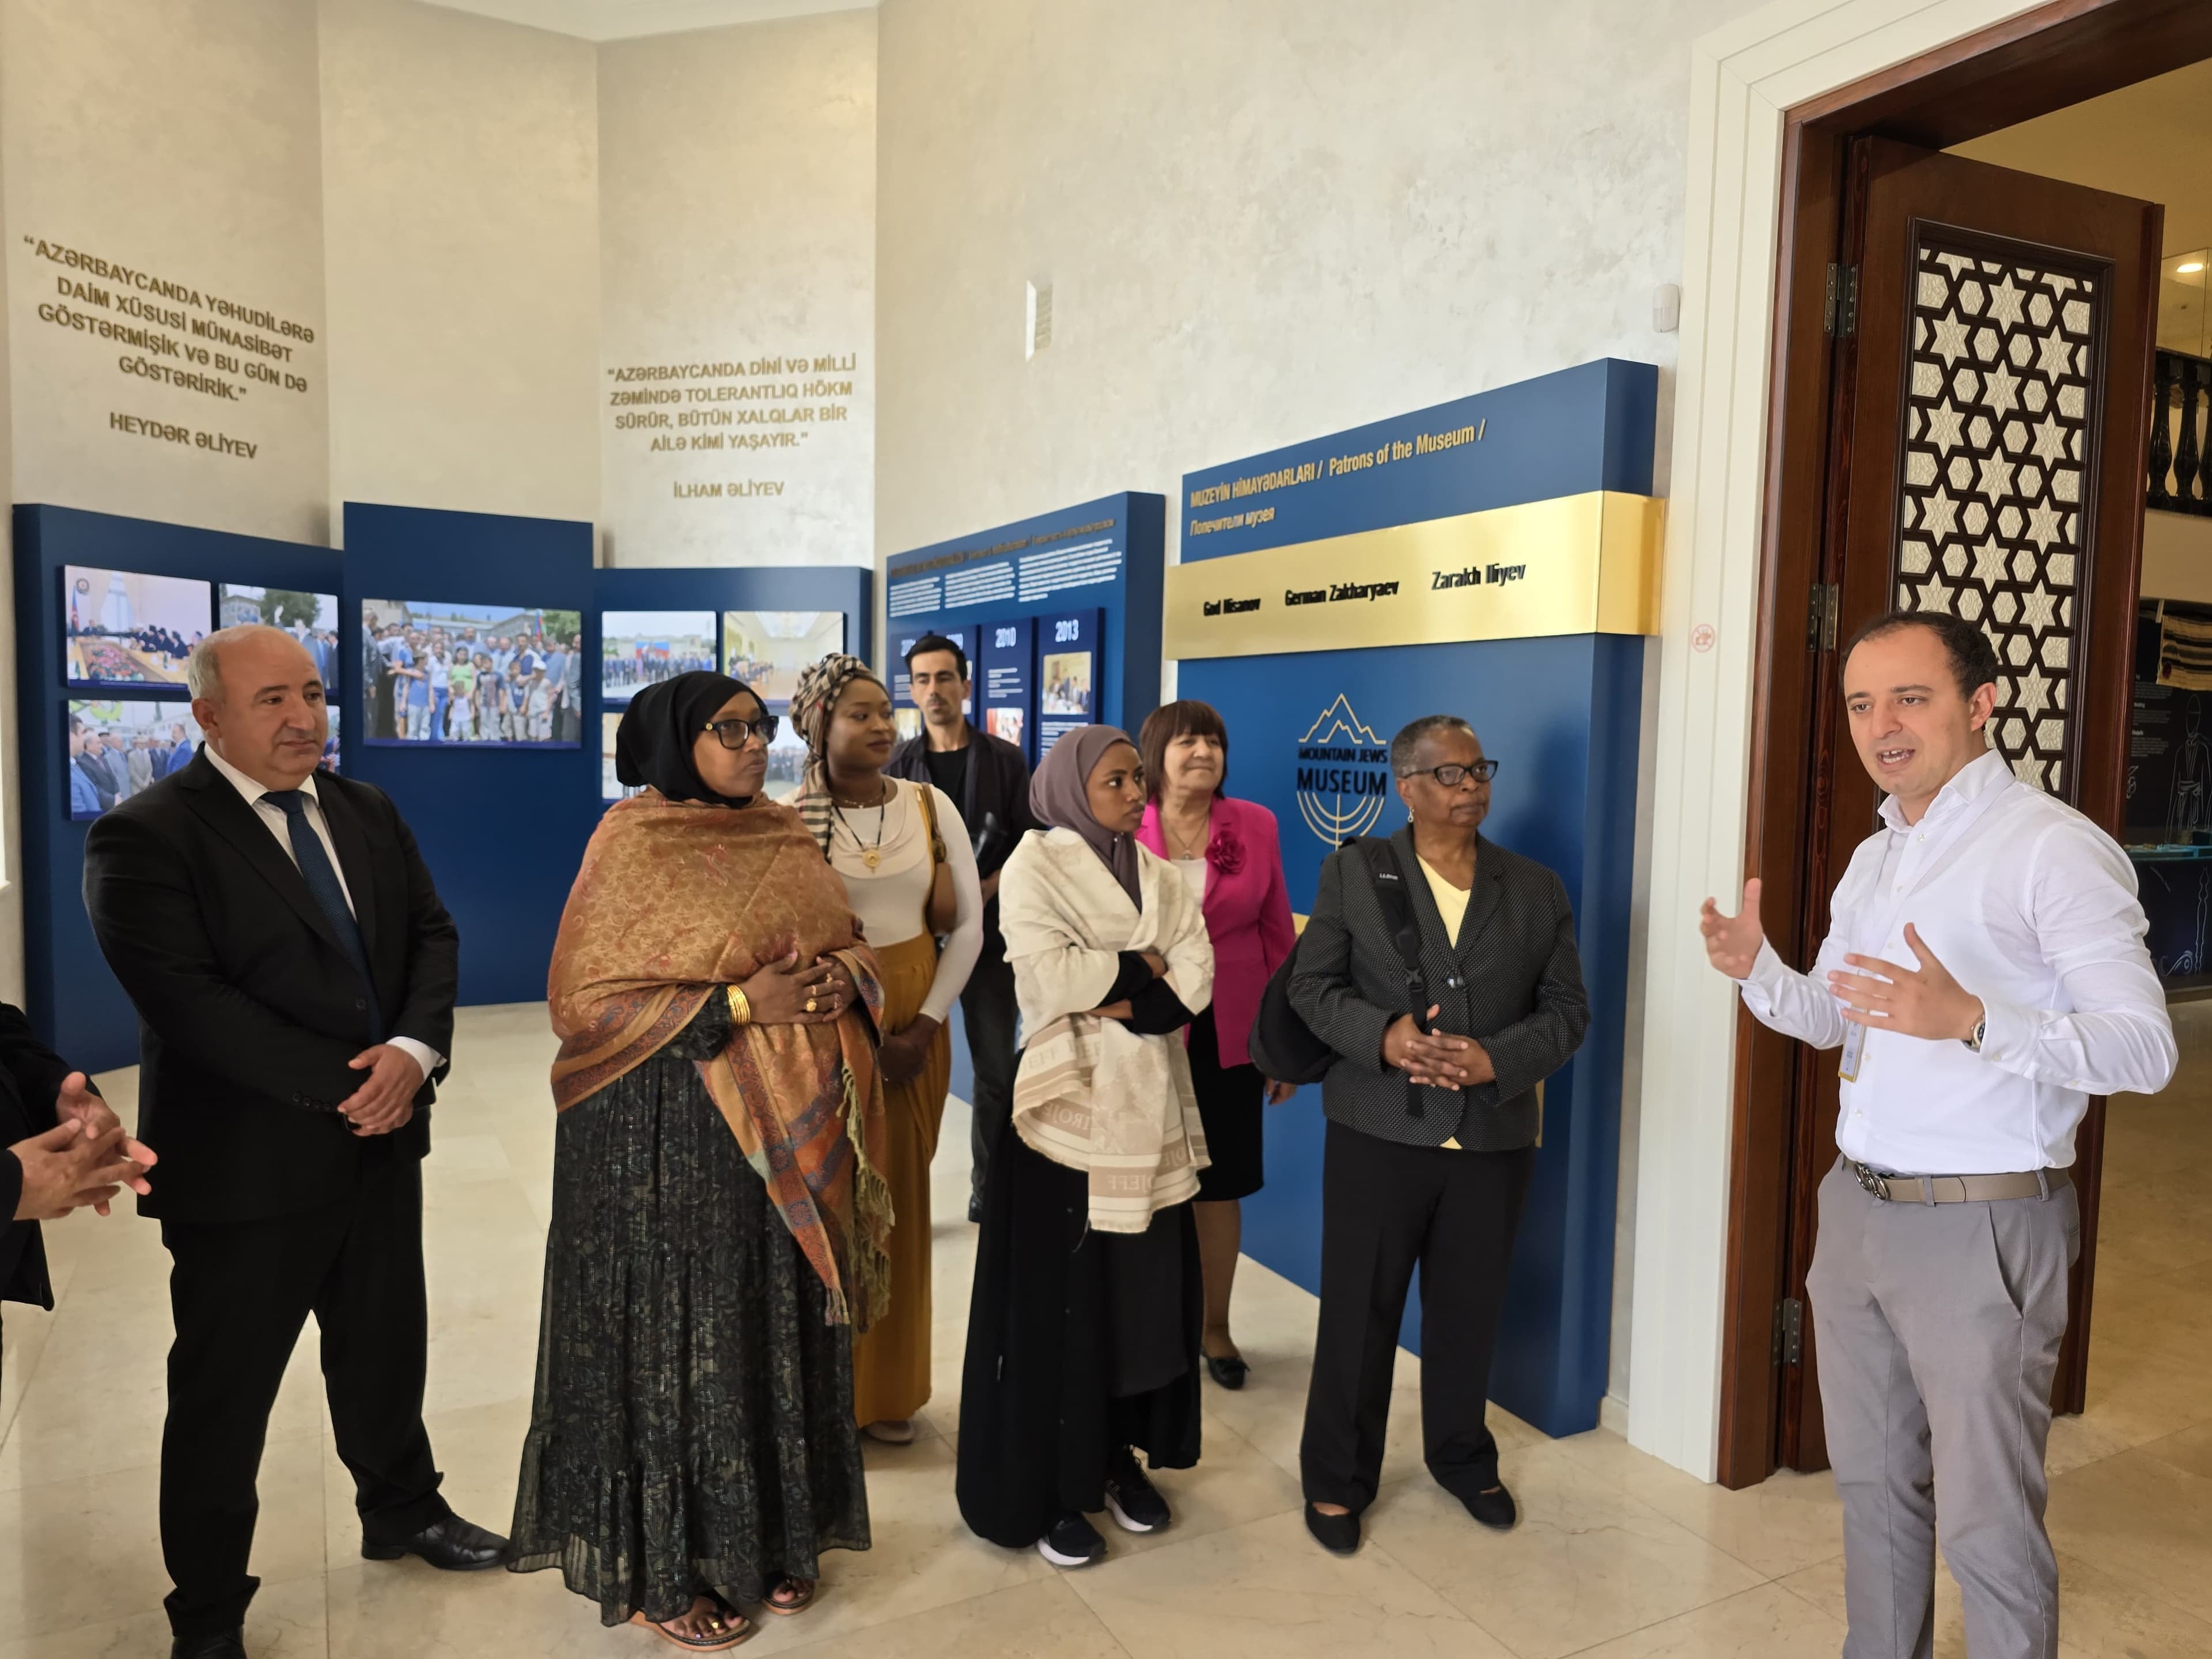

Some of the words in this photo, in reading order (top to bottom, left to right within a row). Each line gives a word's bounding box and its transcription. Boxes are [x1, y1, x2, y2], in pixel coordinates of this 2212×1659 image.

[58, 276, 110, 309] DAİM
[116, 294, 187, 332] XÜSUSİ
[192, 317, 293, 362] MÜNASİBƏT
[206, 294, 315, 343] YƏHUDİLƏRƏ
[38, 302, 180, 358] GÖSTƏRMİŞİK
[184, 343, 210, 365] VƏ
[215, 353, 238, 373] BU
[244, 362, 279, 386] GÜN
[285, 373, 307, 392] DƏ
[749, 355, 782, 376] DİNİ
[786, 358, 809, 373] VƏ
[813, 353, 857, 373] MİLLİ
[610, 387, 681, 407] ZƏMİNDƏ
[684, 383, 799, 403] TOLERANTLIQ
[802, 380, 853, 397] HÖKM
[615, 412, 673, 430] SÜRÜR,
[678, 410, 733, 428] BÜTÜN
[737, 407, 815, 425] XALQLAR
[819, 403, 847, 422] BİR
[110, 411, 190, 445] HEYDƏR
[196, 431, 257, 459] ƏLİYEV
[650, 434, 687, 452] AİLƏ
[691, 432, 724, 450] KİMİ
[1190, 482, 1230, 508] MUZEYİN
[1232, 463, 1315, 499] HİMAYƏDARLARI
[1328, 452, 1374, 476] Patrons
[1376, 443, 1389, 465] of
[1392, 440, 1412, 461] the
[1415, 425, 1475, 455] Museum
[673, 480, 722, 499] İLHAM
[727, 479, 785, 498] ƏLİYEV
[1285, 590, 1326, 607] German
[1055, 619, 1080, 643] 2013
[1298, 746, 1356, 762] MOUNTAIN
[1358, 749, 1388, 764] JEWS
[1296, 767, 1387, 796] MUSEUM
